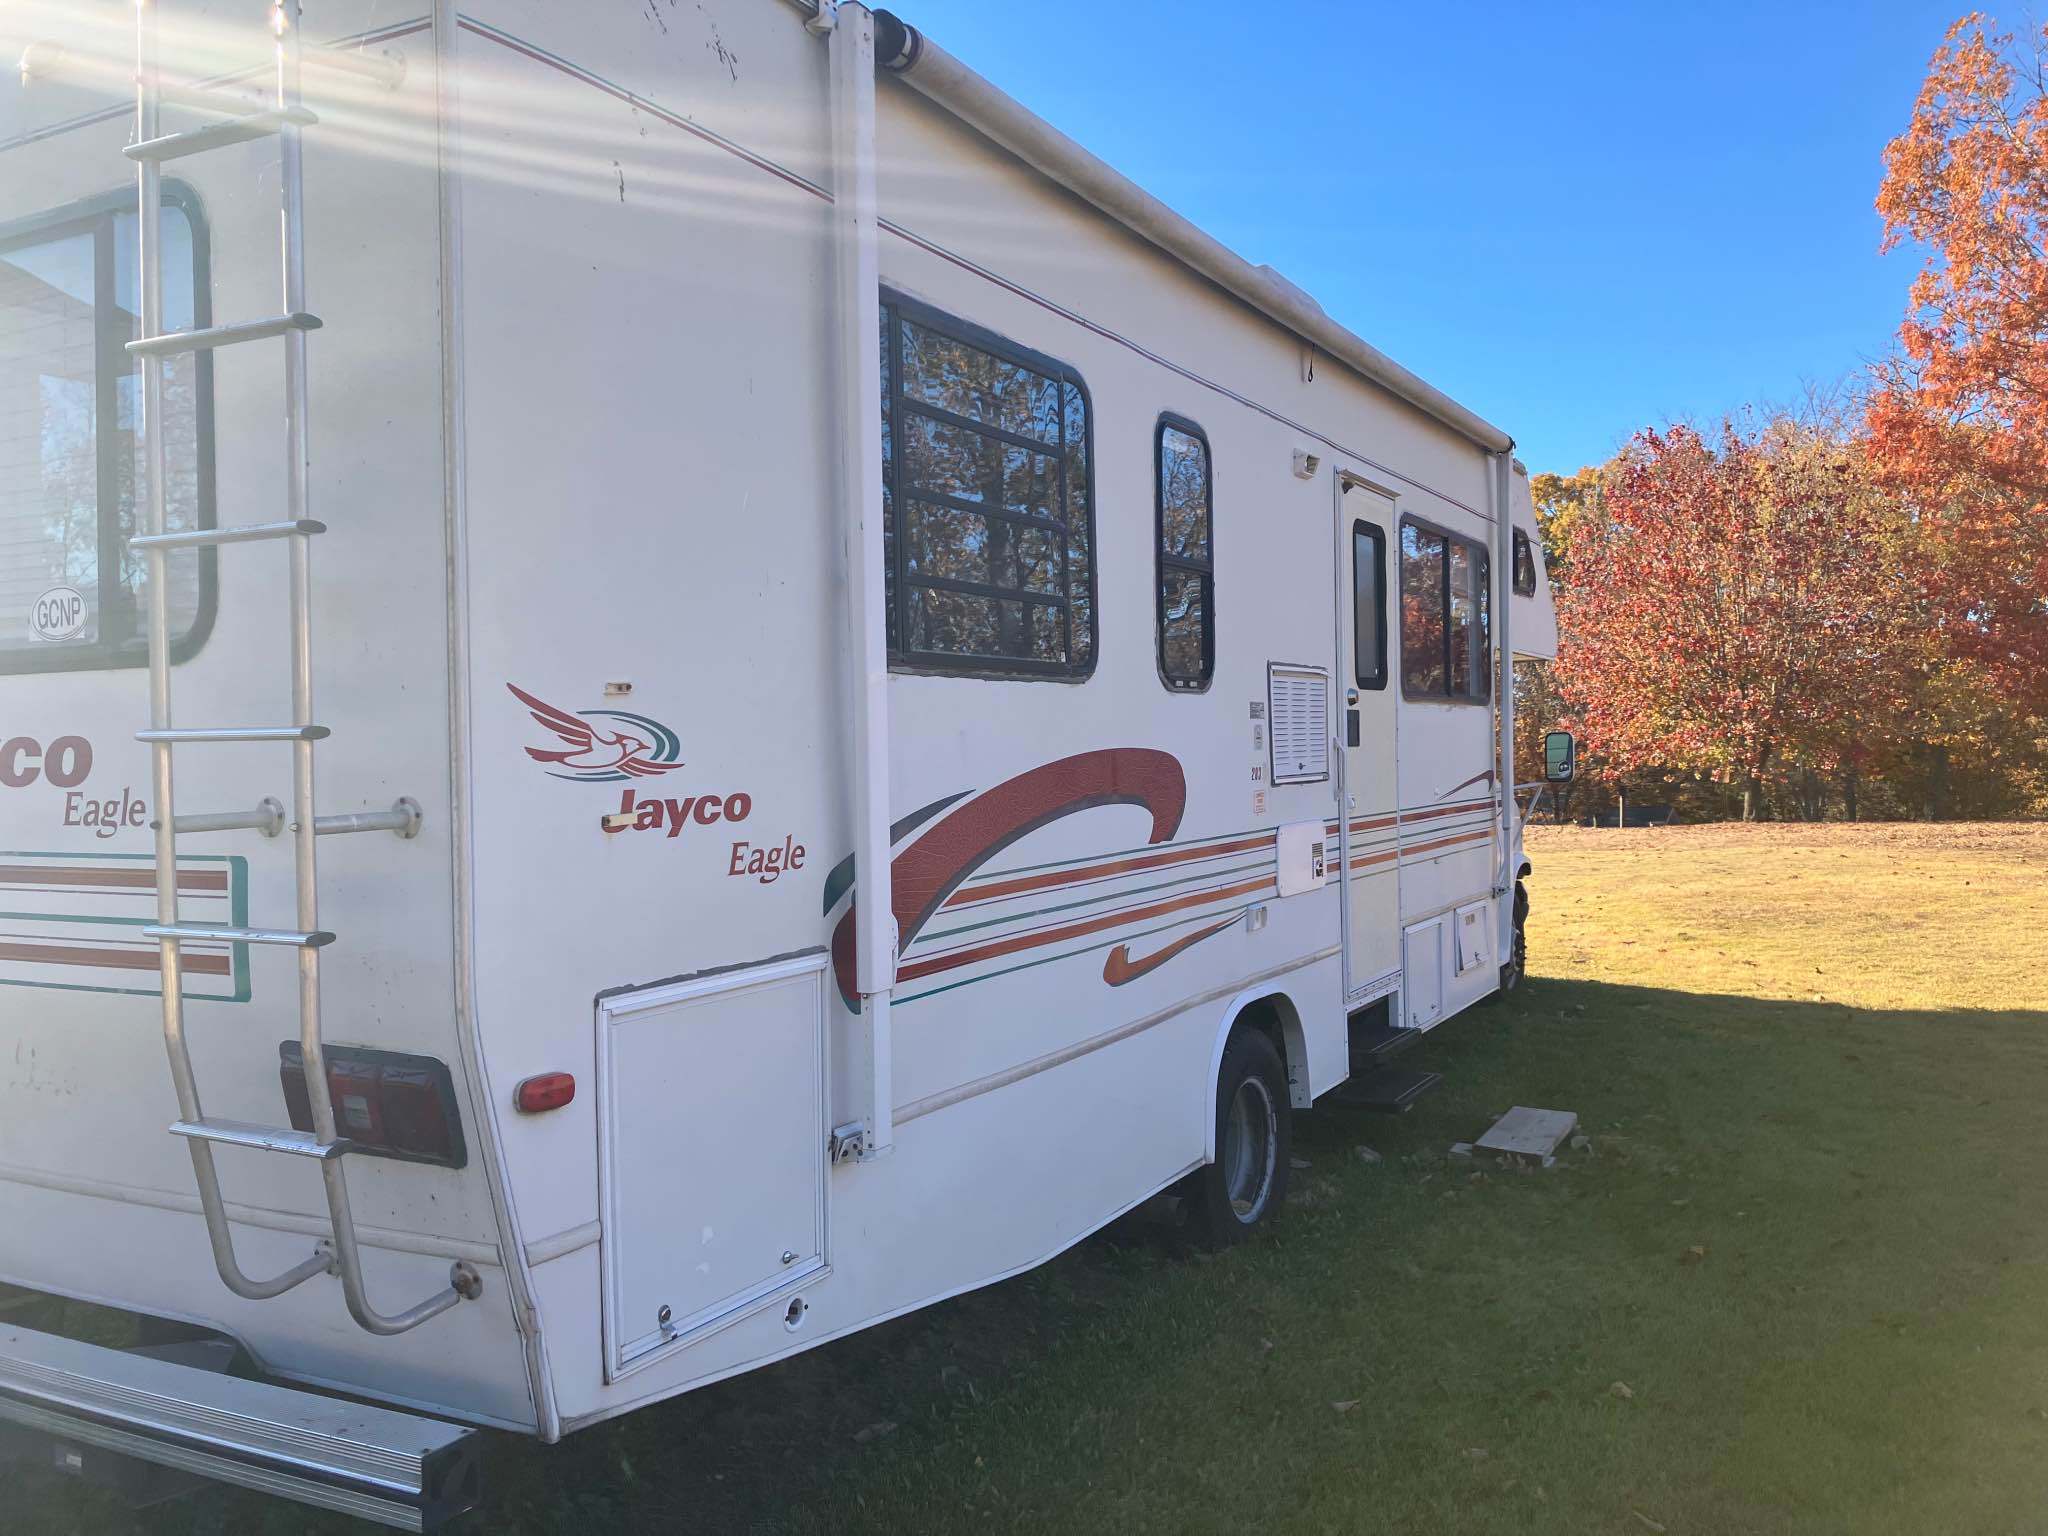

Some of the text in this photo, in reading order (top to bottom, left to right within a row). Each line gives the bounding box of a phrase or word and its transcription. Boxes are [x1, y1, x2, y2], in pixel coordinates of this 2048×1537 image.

[37, 597, 82, 629] GCNP
[0, 735, 93, 788] co
[62, 786, 147, 839] Eagle
[601, 789, 752, 838] Jayco
[727, 834, 806, 884] Eagle
